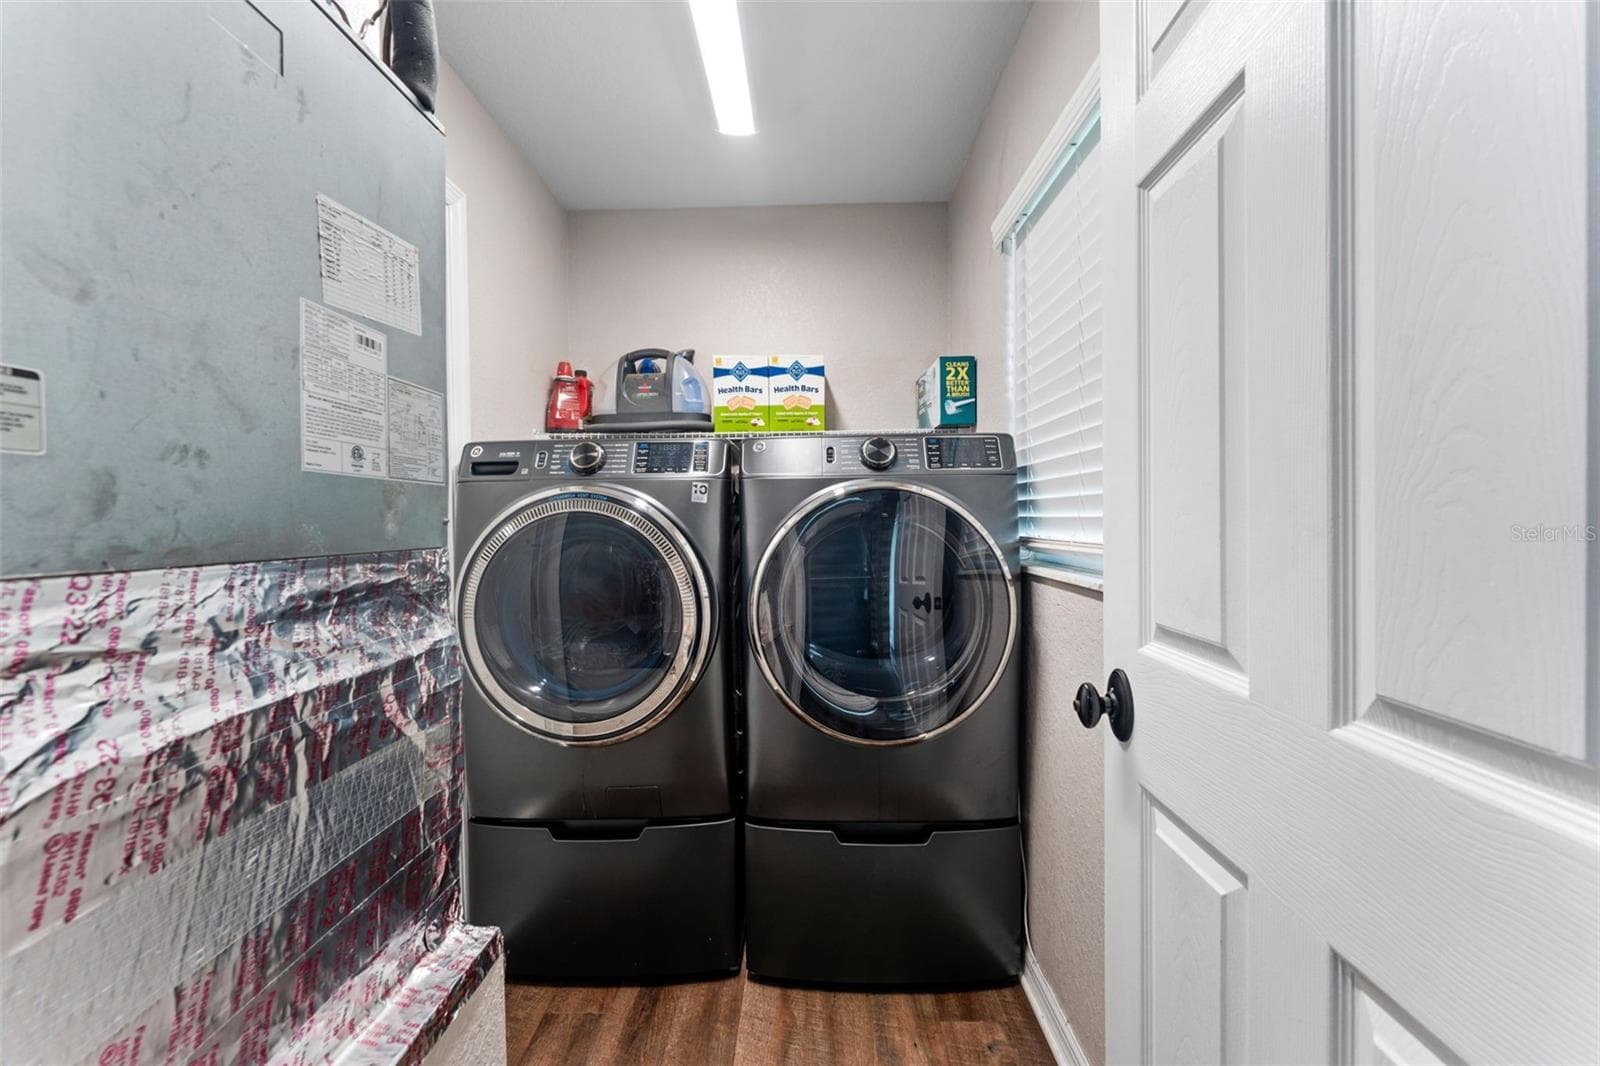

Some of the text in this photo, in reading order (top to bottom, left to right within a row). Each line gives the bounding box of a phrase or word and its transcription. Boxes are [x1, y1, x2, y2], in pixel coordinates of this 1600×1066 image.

[945, 367, 970, 380] 2X
[717, 385, 763, 395] Health Bars
[774, 384, 819, 394] Health Bars
